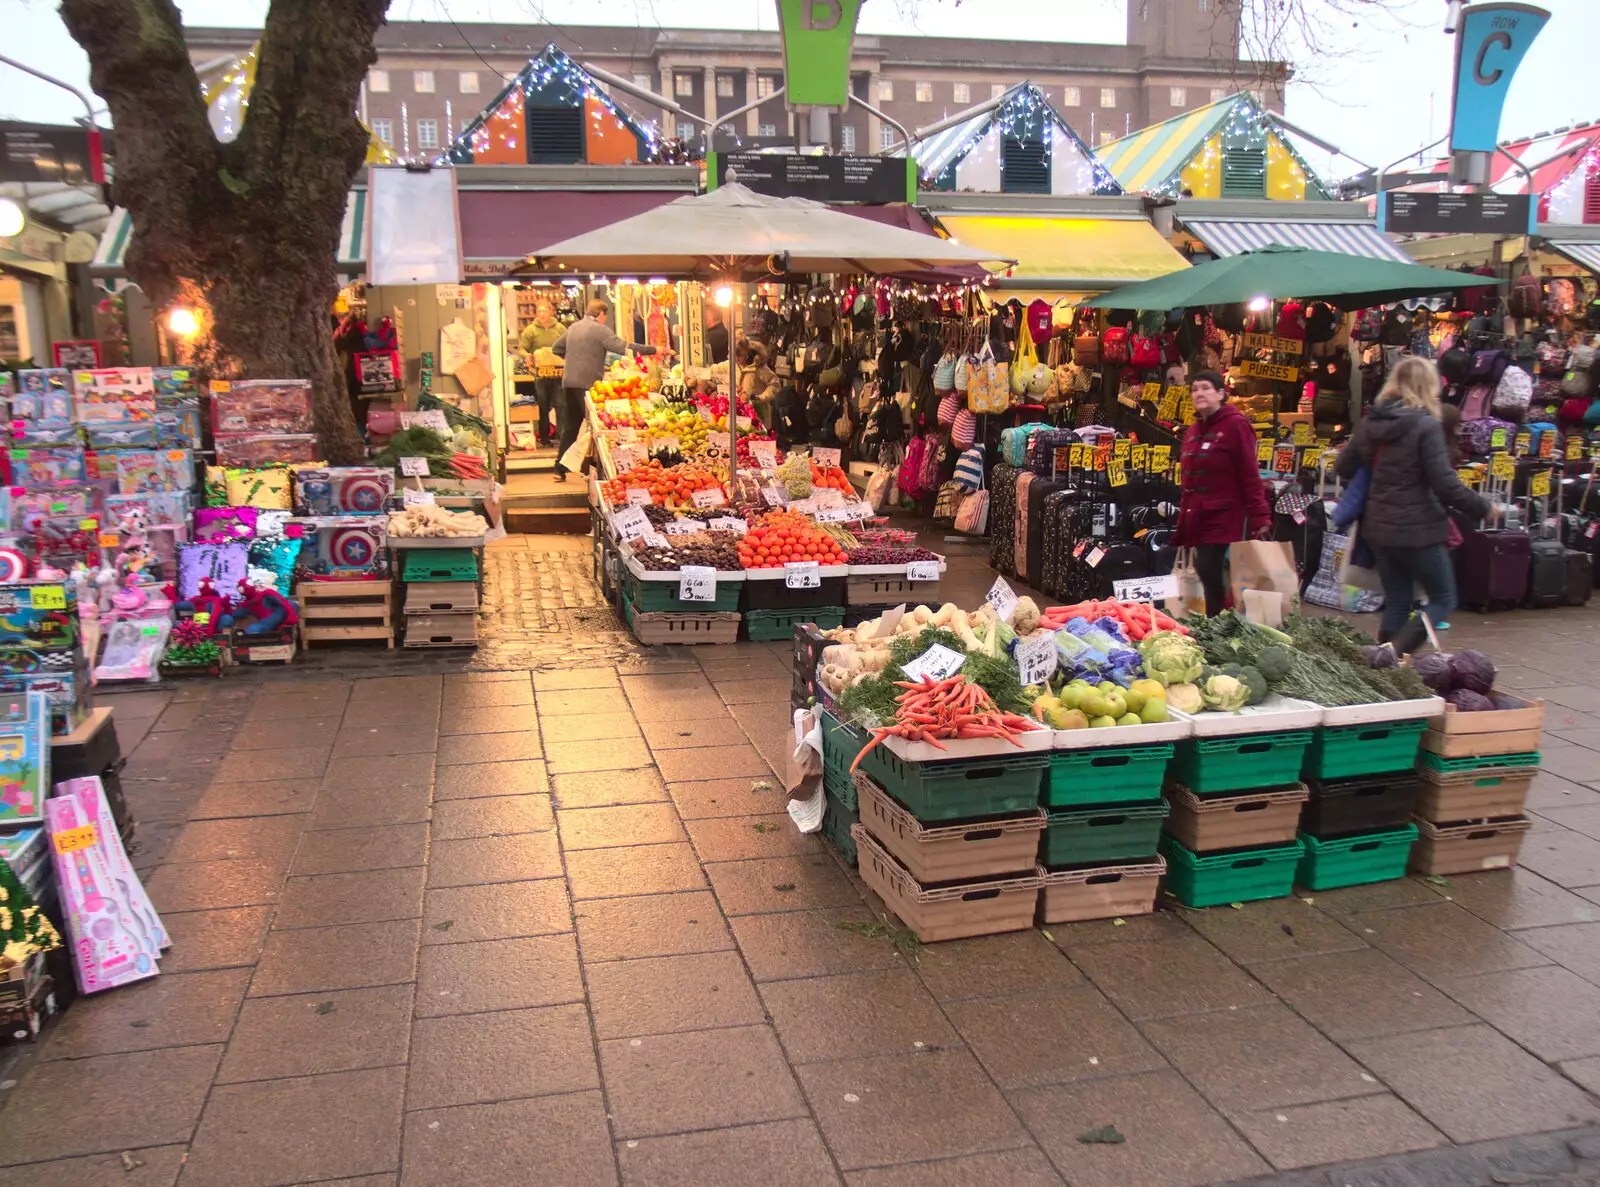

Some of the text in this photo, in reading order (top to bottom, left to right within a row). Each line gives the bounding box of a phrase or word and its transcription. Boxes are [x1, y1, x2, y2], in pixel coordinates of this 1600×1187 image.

[1491, 15, 1520, 29] ROW
[1473, 31, 1512, 86] C
[691, 296, 701, 358] HERBS
[1249, 335, 1297, 352] WALLETS
[1248, 363, 1290, 379] PURSES
